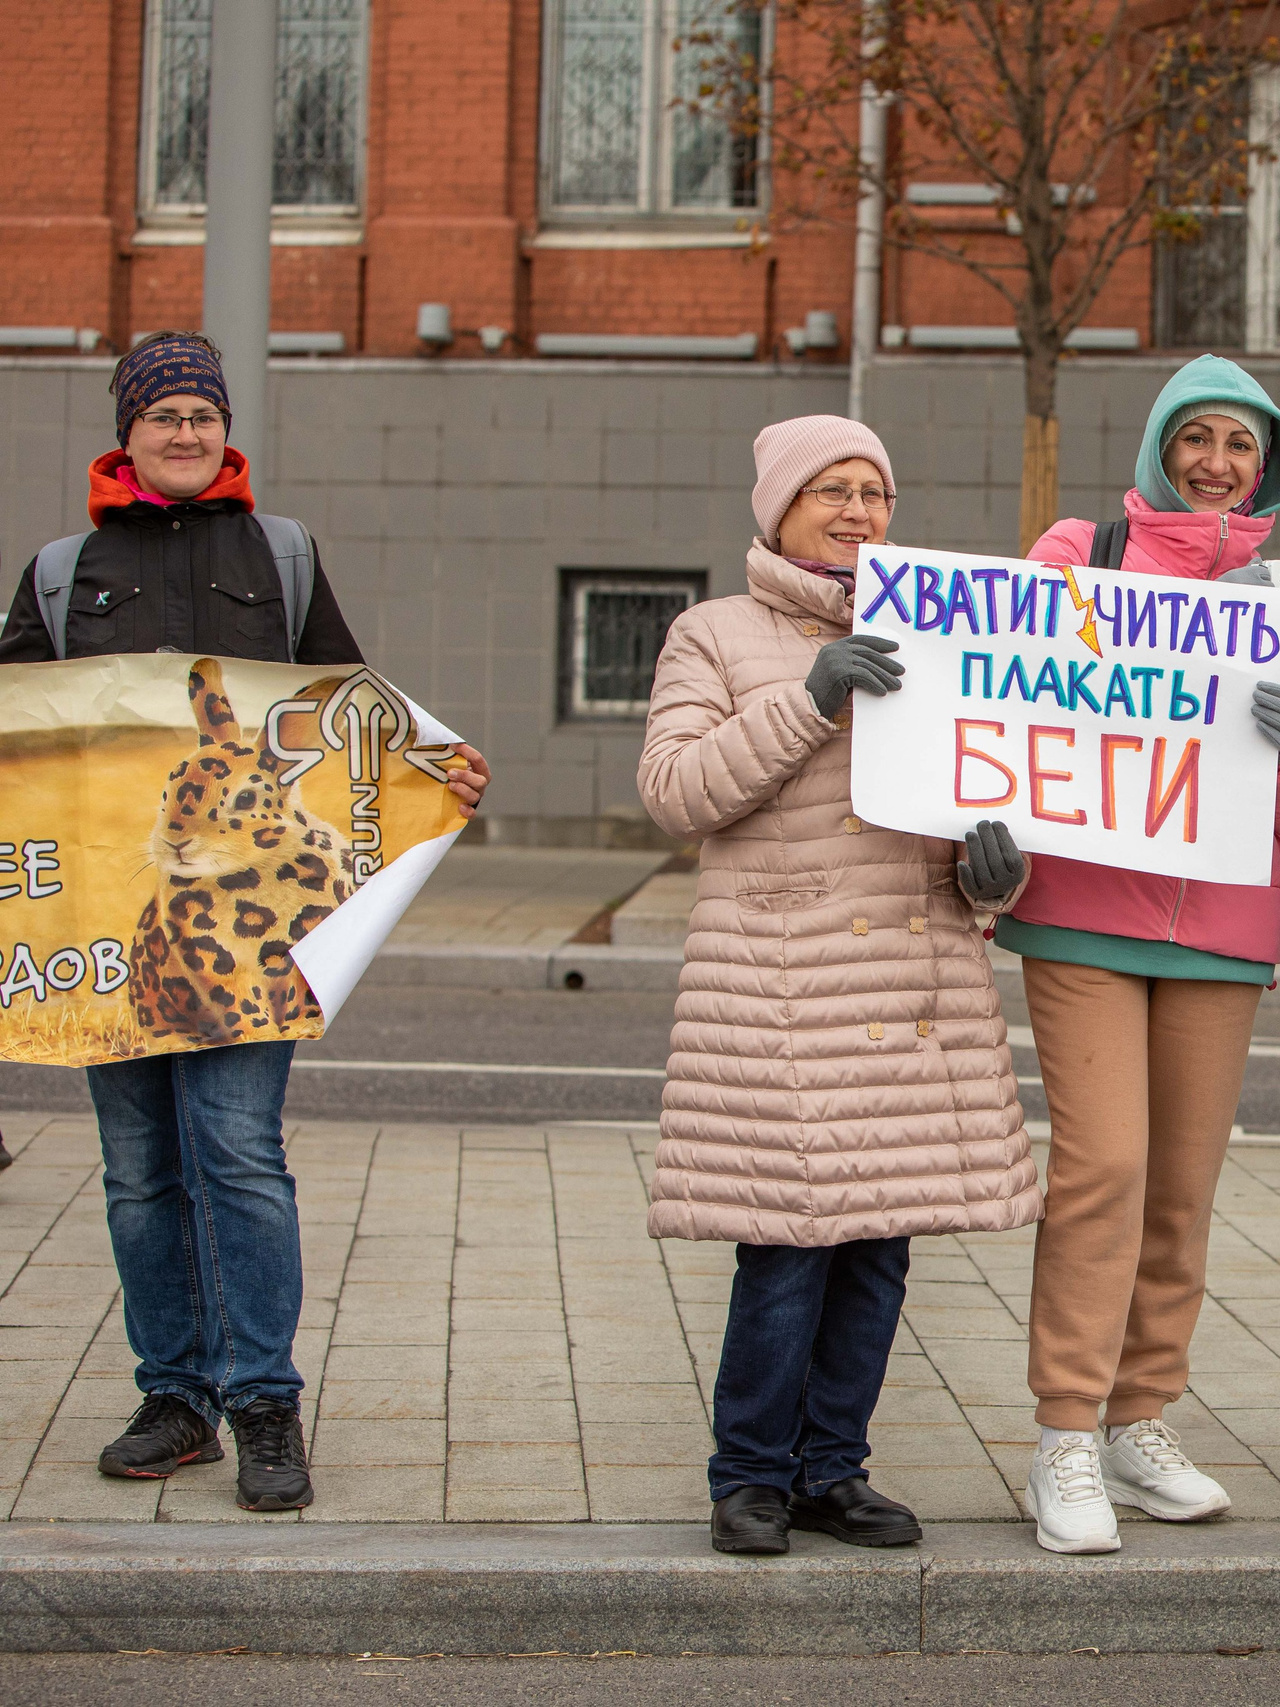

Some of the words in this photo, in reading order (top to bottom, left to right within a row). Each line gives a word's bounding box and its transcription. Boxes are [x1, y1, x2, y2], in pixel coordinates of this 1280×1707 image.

[860, 557, 1068, 638] ХВАТИТ
[1094, 583, 1280, 664] ЧИТАТЬ
[961, 650, 1220, 724] ПЛАКАТЫ
[953, 717, 1202, 844] БЕГИ
[350, 783, 384, 886] RUN
[0, 937, 131, 1009] ДОВ
